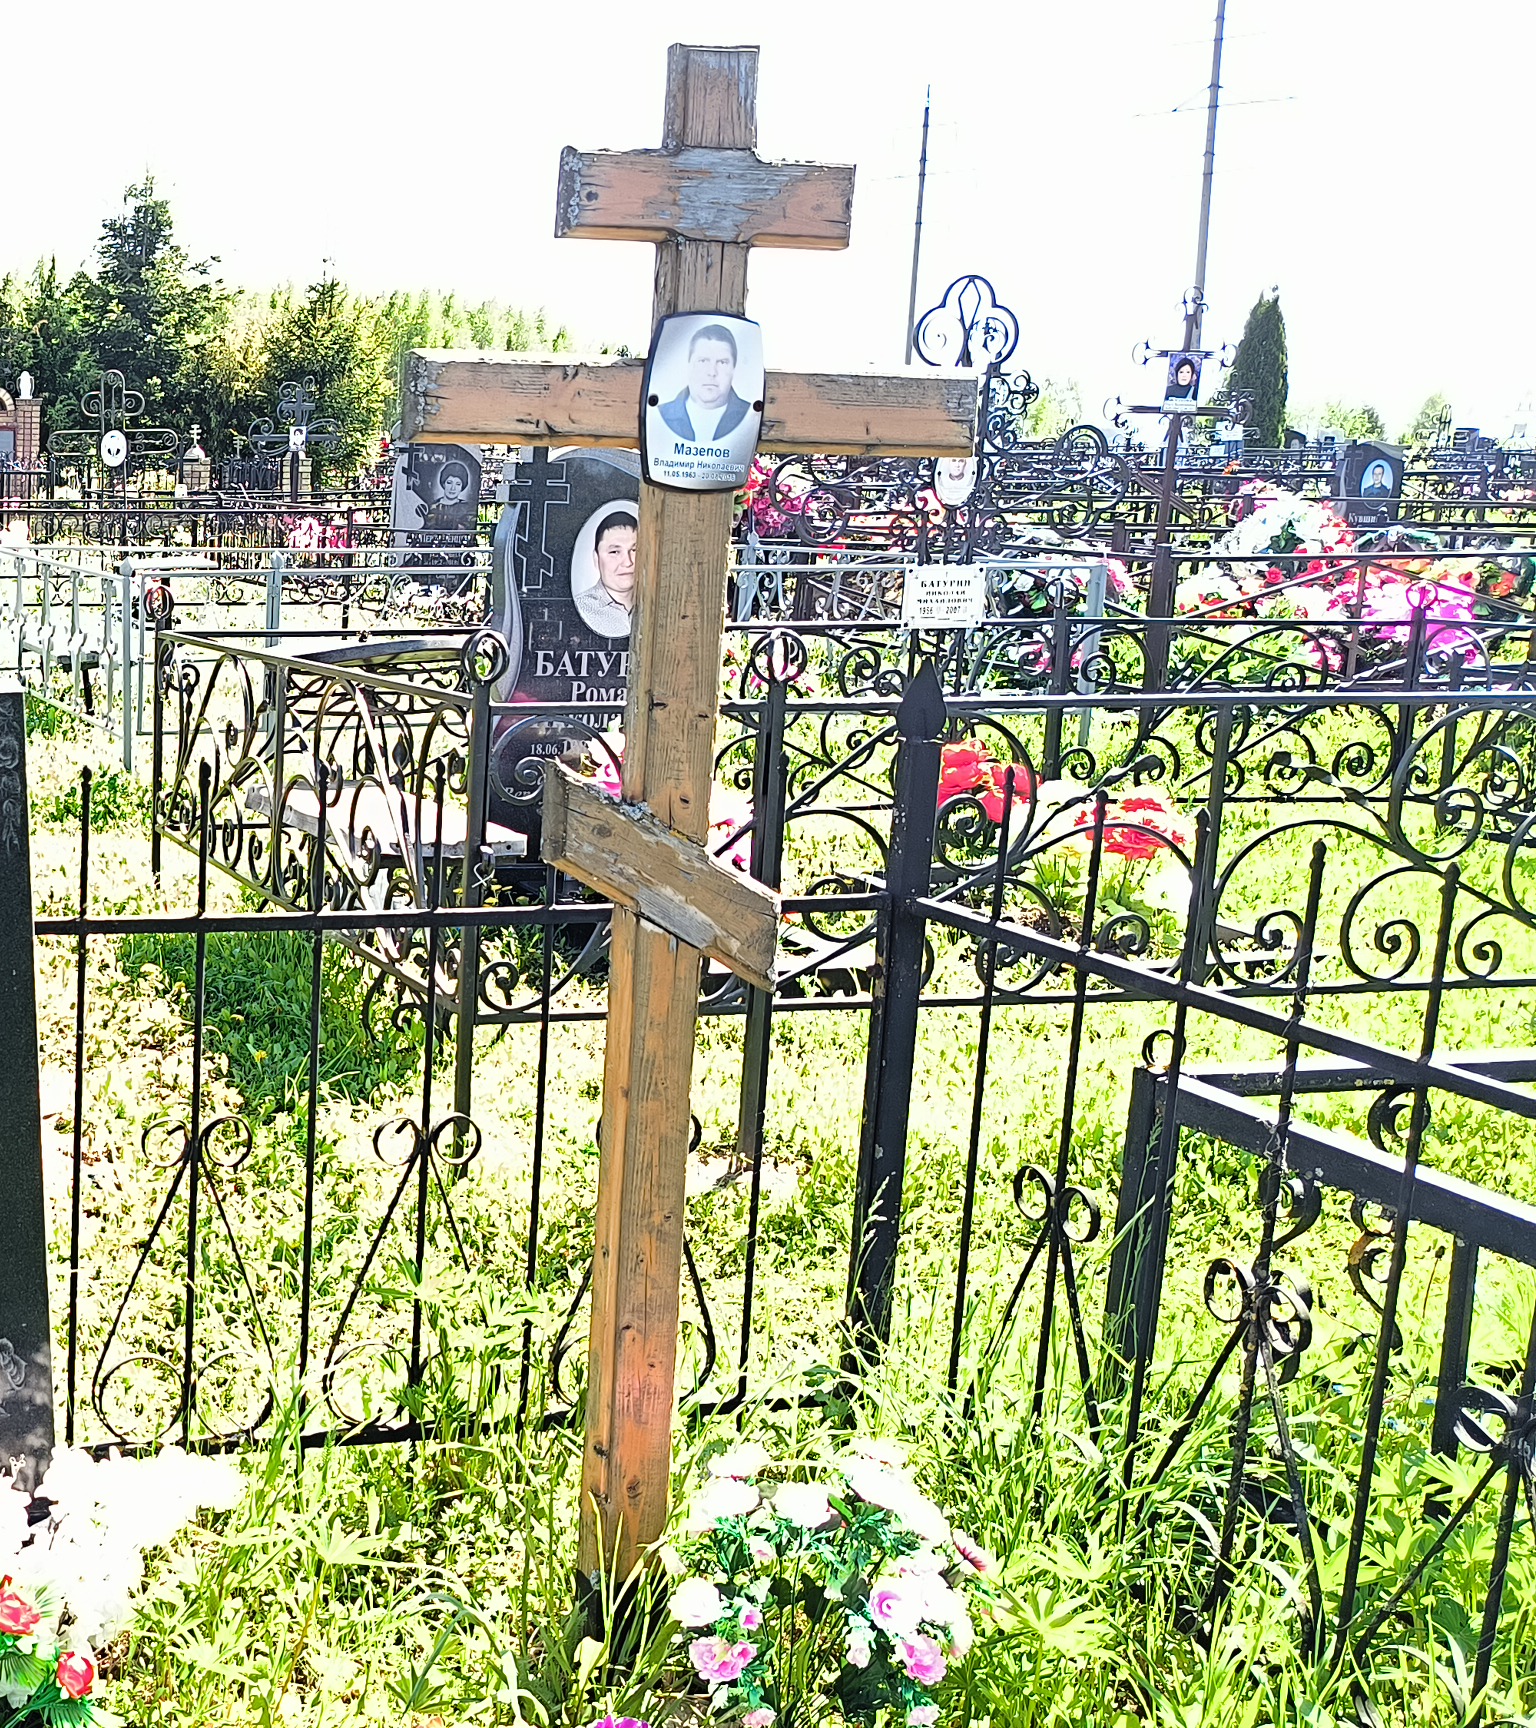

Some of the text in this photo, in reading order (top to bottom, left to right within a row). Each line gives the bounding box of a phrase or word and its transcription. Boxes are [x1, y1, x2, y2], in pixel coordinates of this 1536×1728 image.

[674, 443, 730, 458] Мазепов
[654, 458, 745, 472] Владимир Николаевич
[920, 579, 971, 588] БАТУРИН
[570, 681, 628, 702] Рома
